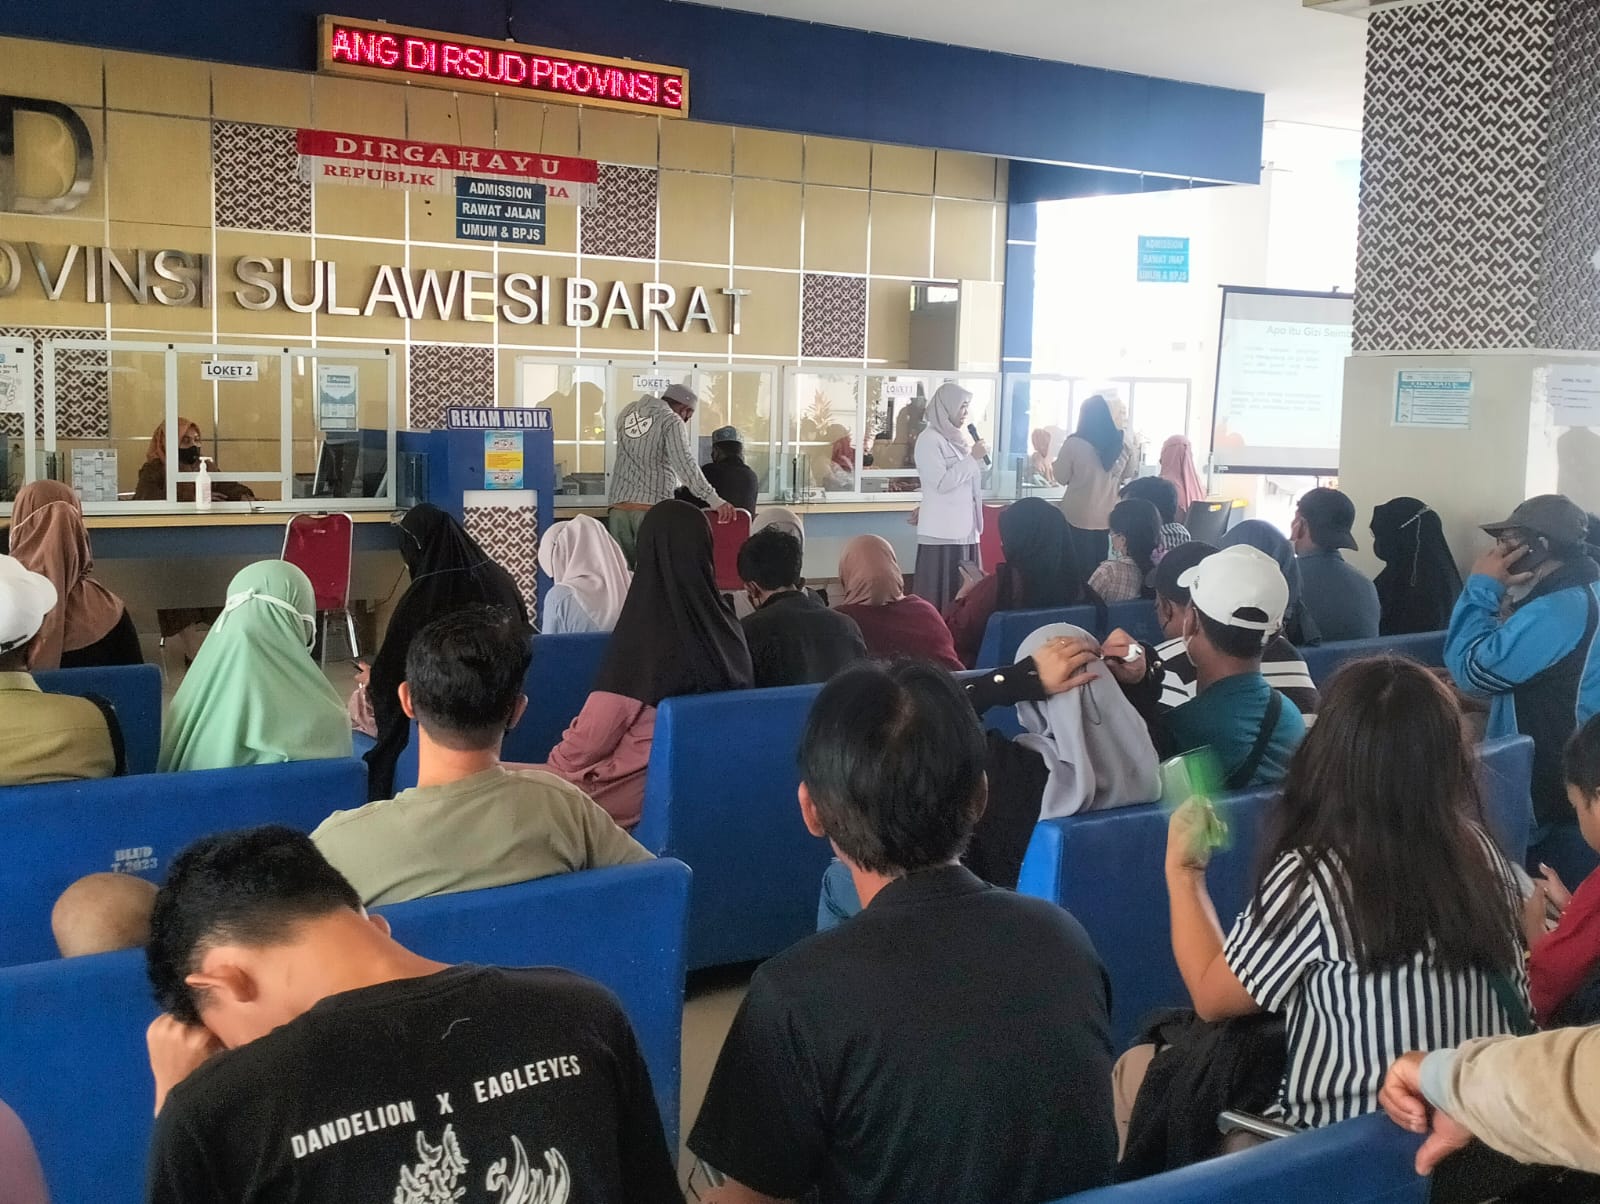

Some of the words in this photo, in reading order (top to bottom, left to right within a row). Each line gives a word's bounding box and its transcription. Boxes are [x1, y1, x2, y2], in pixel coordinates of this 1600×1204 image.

[332, 30, 399, 67] ANG
[406, 40, 435, 72] DI
[443, 46, 526, 84] RSUD
[532, 58, 659, 103] PROVINSI
[664, 79, 683, 106] S
[335, 137, 561, 176] DIRGAHAYU
[323, 164, 435, 187] REPUBLIK
[469, 182, 532, 199] ADMISSION
[462, 202, 502, 217] RAWAT
[504, 206, 541, 220] JALAN
[462, 223, 497, 237] UMUM
[500, 226, 509, 238] &
[512, 227, 541, 241] BPJS
[234, 255, 550, 326] SULAWESI
[565, 277, 752, 335] BARAT
[207, 365, 243, 376] LOKET
[245, 366, 253, 376] 2
[636, 378, 664, 388] LOKET
[451, 408, 501, 428] REKAM
[503, 410, 549, 429] MEDIK
[291, 1100, 416, 1159] DANDELION
[438, 1091, 454, 1114] X
[473, 1054, 582, 1104] EAGLEEYES
